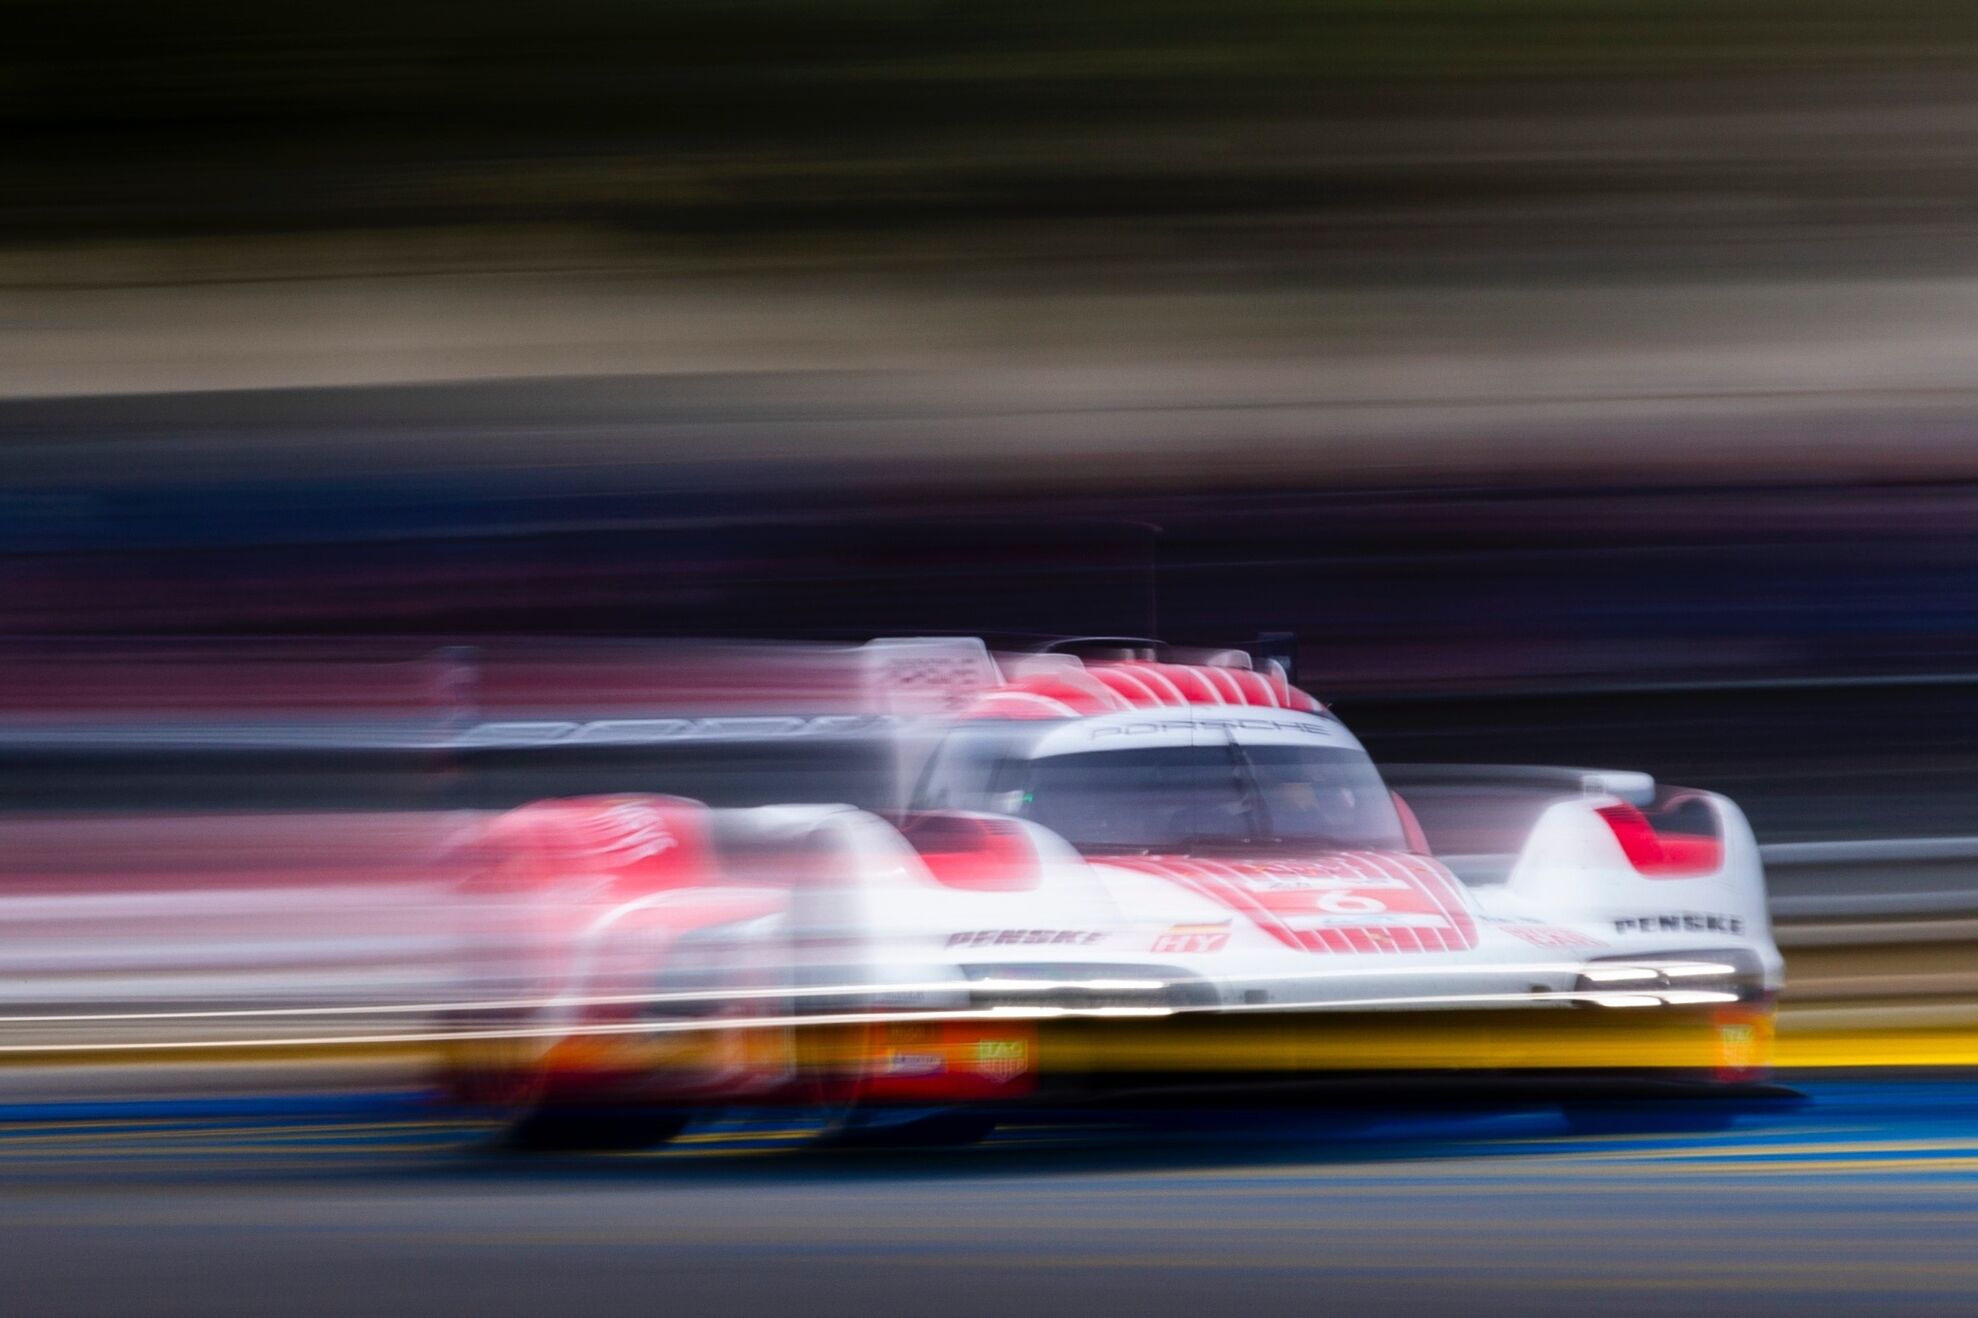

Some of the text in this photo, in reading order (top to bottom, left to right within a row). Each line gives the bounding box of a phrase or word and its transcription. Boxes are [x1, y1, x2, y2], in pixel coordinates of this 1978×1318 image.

[1316, 889, 1387, 914] 6
[1614, 914, 1746, 936] PENSKE
[946, 929, 1106, 949] PENSKE
[1152, 933, 1228, 952] HY
